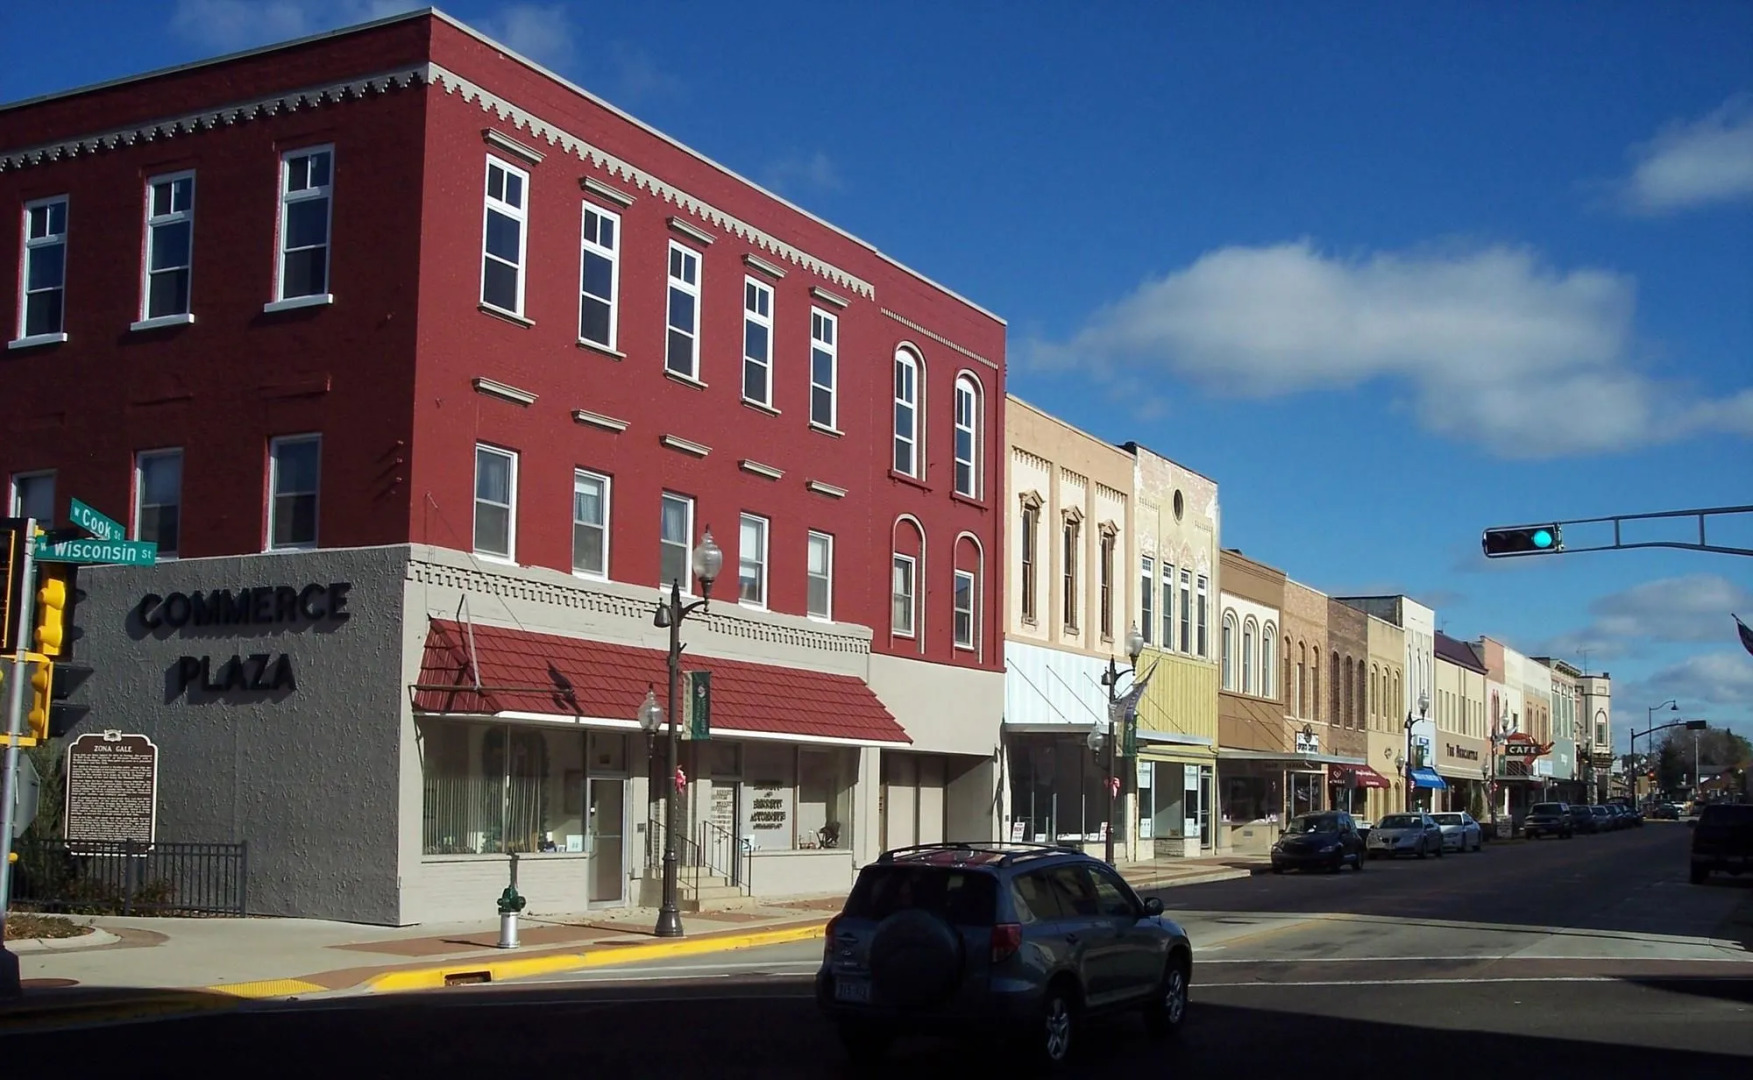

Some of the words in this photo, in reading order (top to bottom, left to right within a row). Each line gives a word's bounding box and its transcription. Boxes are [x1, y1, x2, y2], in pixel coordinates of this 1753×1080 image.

[82, 509, 111, 541] Cook
[114, 530, 121, 541] St
[55, 541, 136, 562] Wisconsin
[141, 549, 152, 559] St
[139, 582, 351, 629] COMMERCE
[178, 652, 298, 692] PLAZA
[115, 745, 132, 753] GALE
[1509, 746, 1536, 754] CAFE
